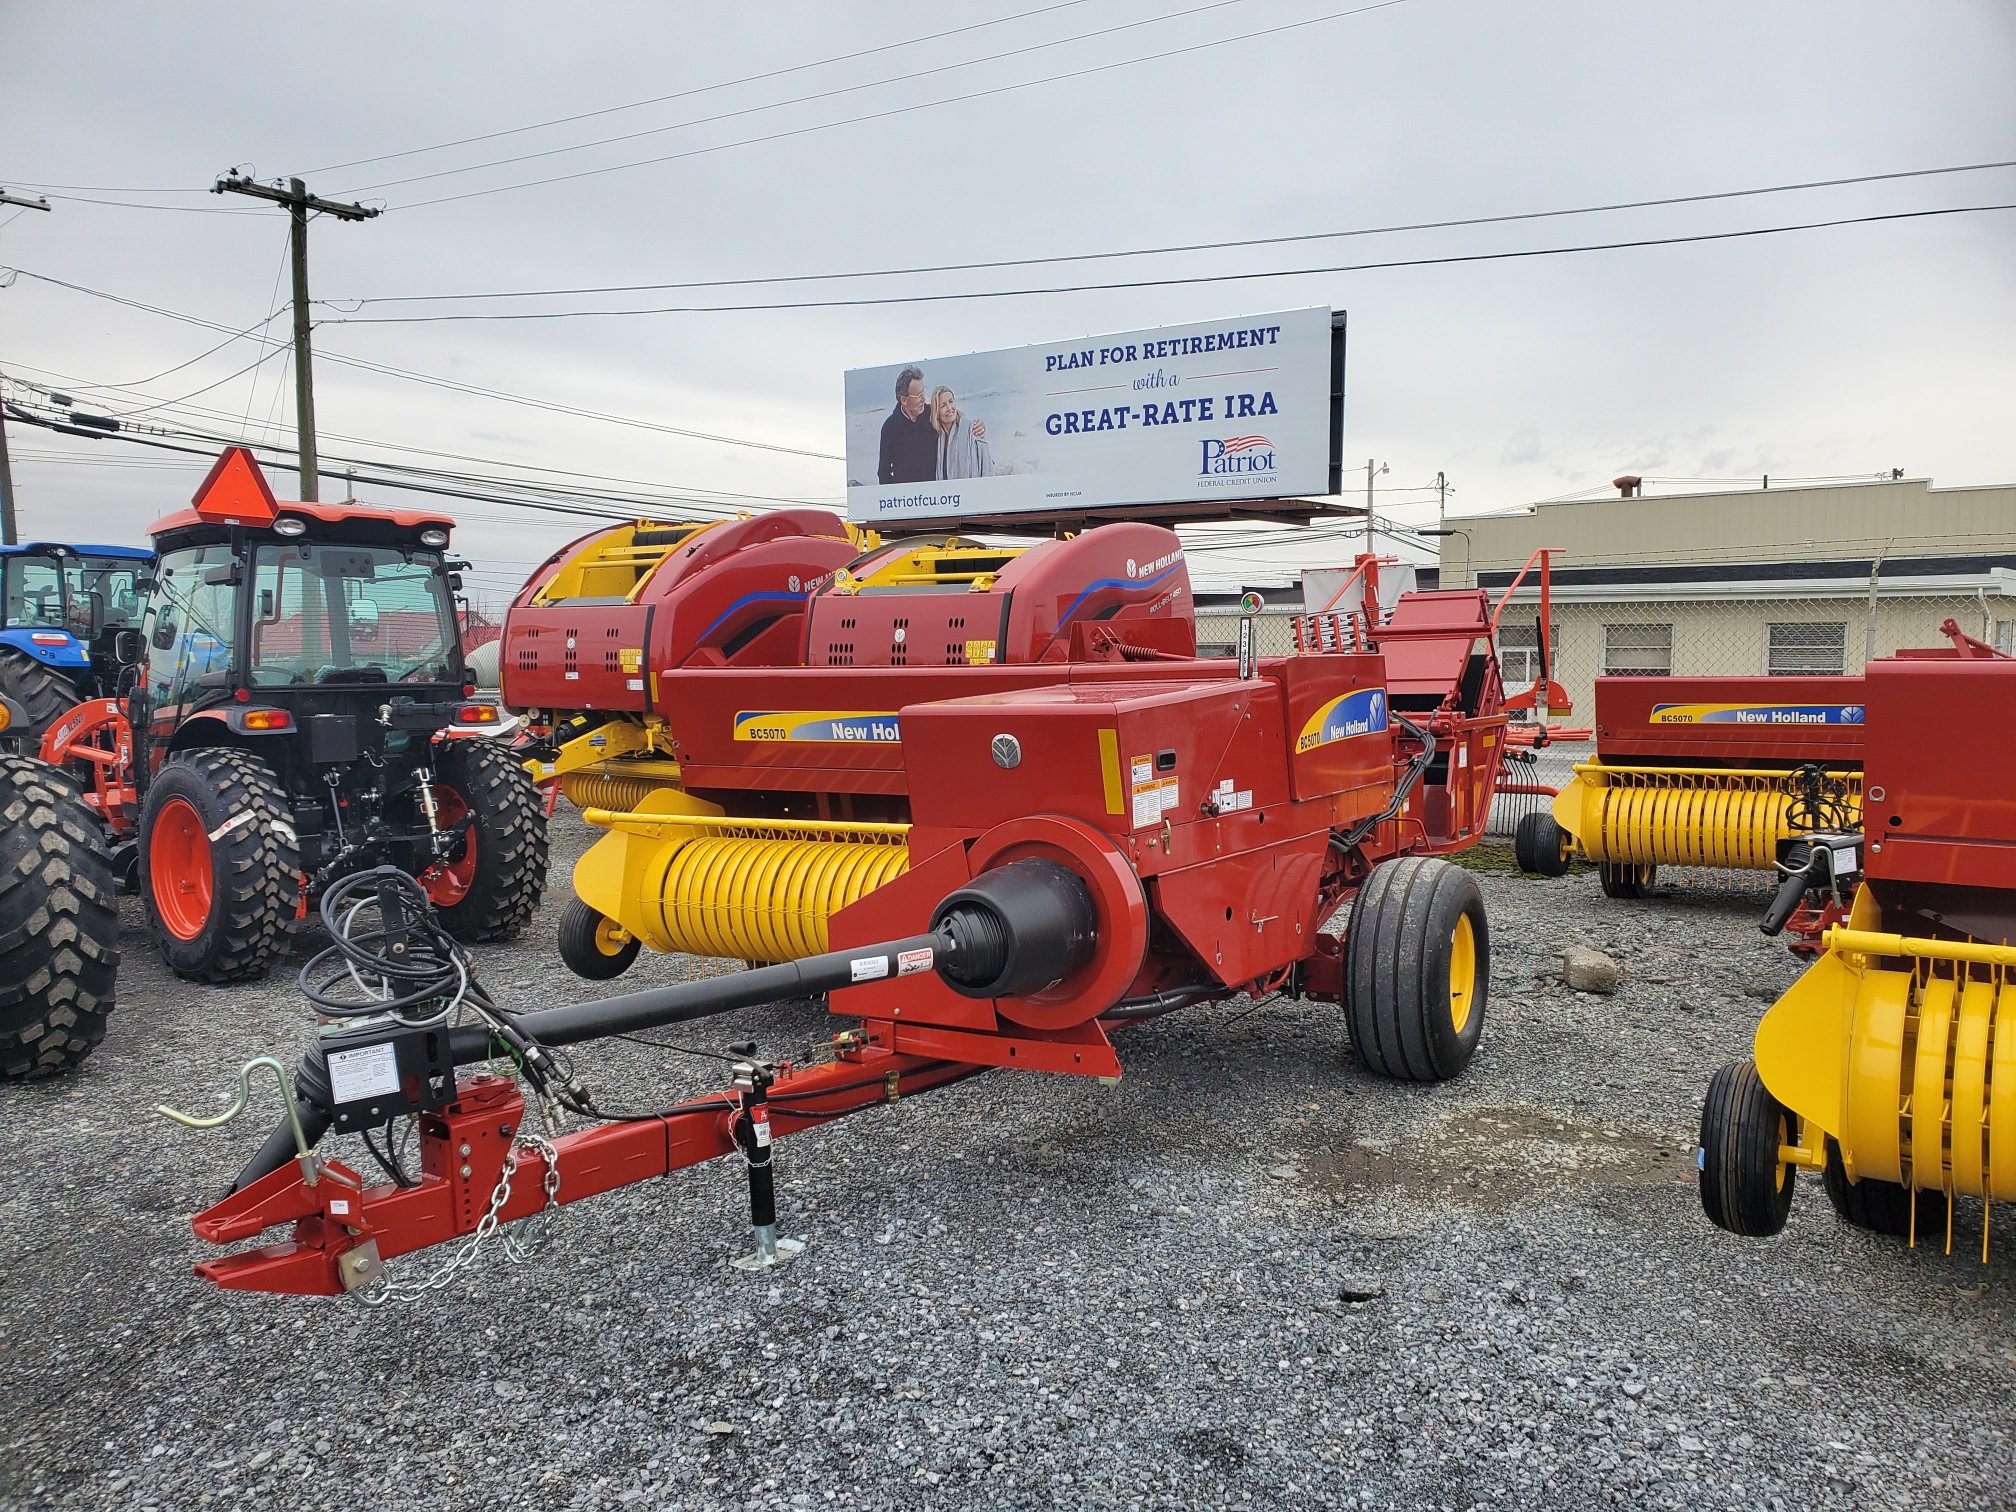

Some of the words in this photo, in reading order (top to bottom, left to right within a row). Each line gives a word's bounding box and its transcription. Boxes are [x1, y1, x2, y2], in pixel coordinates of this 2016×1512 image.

[1046, 350, 1094, 372] PLAN
[1099, 345, 1138, 365] FOR
[1143, 326, 1281, 360] RETIREMENT
[1132, 368, 1167, 391] with
[1168, 374, 1181, 387] a
[1045, 397, 1214, 436] GREAT-RATE
[1224, 391, 1278, 419] IRA
[1197, 439, 1277, 475] Patriot
[1197, 480, 1225, 488] FEDERAL
[1226, 478, 1252, 486] CREDIT
[1252, 476, 1277, 484] UNION
[879, 493, 960, 511] patriotfcu.org
[1139, 561, 1155, 578] NEW
[1155, 548, 1184, 571] HOLLAND
[804, 575, 824, 592] NEW
[1661, 715, 1693, 723] BC5070
[1736, 711, 1768, 723] New
[1772, 711, 1826, 723] Holland
[750, 728, 786, 739] BC5070
[831, 722, 867, 740] New
[1300, 731, 1321, 750] BC5070
[1330, 725, 1345, 740] New
[1345, 718, 1369, 736] Holland
[907, 951, 931, 962] DANGER
[348, 1047, 385, 1059] IMPORTANT
